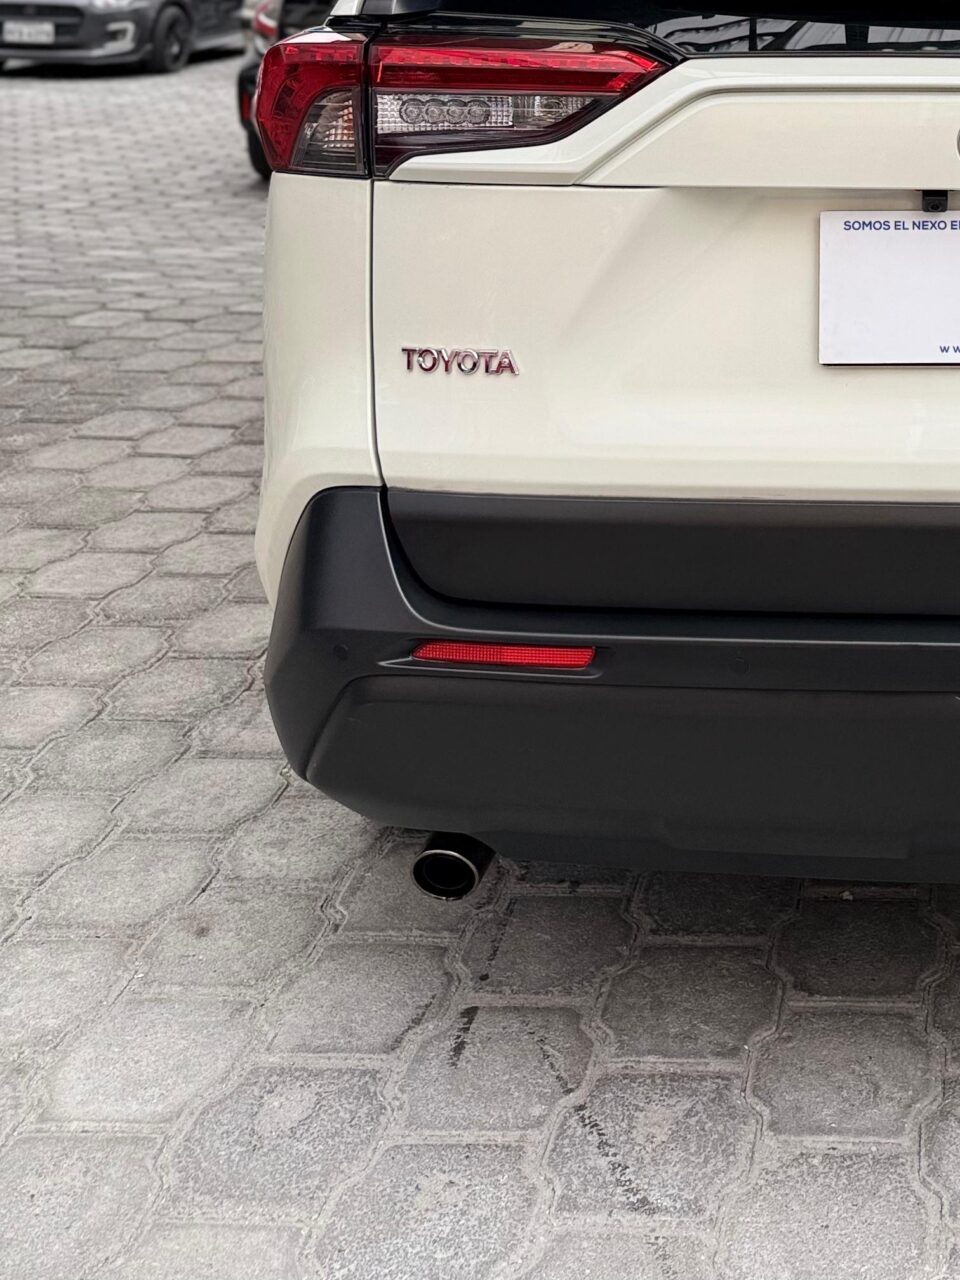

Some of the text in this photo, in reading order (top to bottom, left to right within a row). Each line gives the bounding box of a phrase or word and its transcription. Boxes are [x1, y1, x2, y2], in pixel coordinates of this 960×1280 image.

[843, 220, 891, 231] SOMOS
[894, 220, 910, 230] EL
[912, 220, 947, 231] NEXO
[401, 346, 520, 375] TOYOTA
